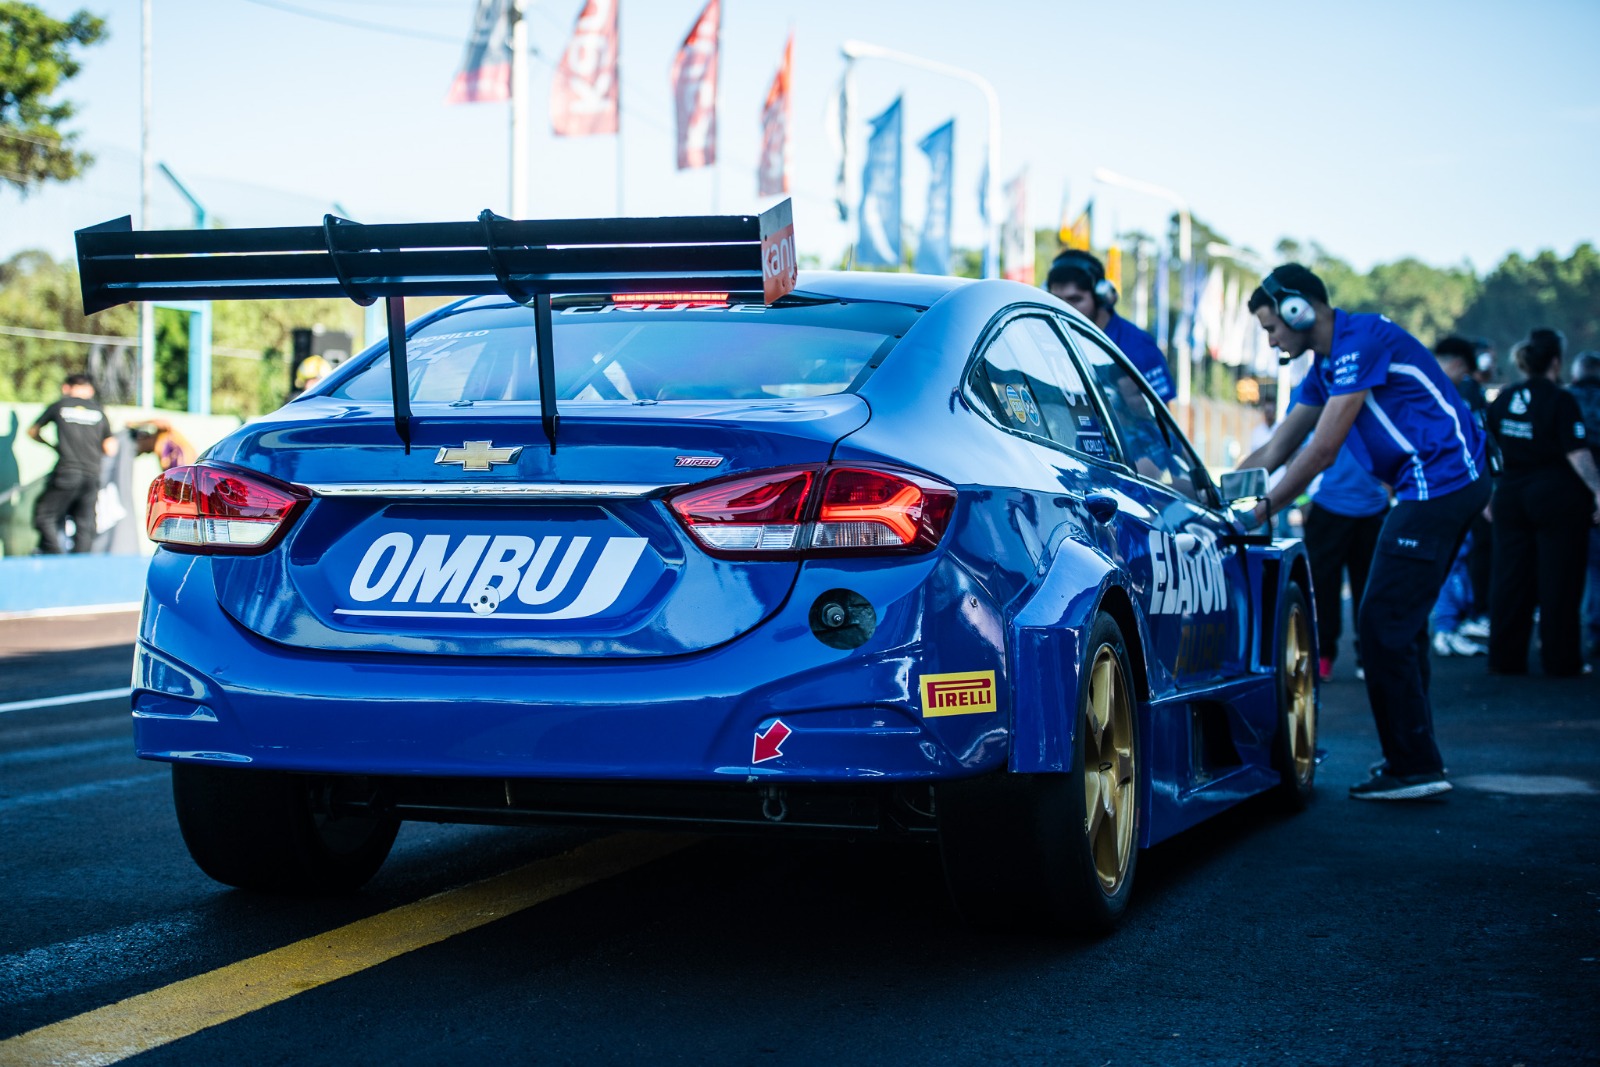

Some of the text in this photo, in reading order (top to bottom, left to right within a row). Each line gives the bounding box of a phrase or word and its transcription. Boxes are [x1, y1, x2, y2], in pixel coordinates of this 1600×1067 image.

[560, 303, 771, 315] CRUZE
[407, 329, 490, 344] MORILLO
[675, 456, 722, 467] TURBO
[349, 531, 592, 606] OMBU
[926, 678, 992, 708] PIRELLI
